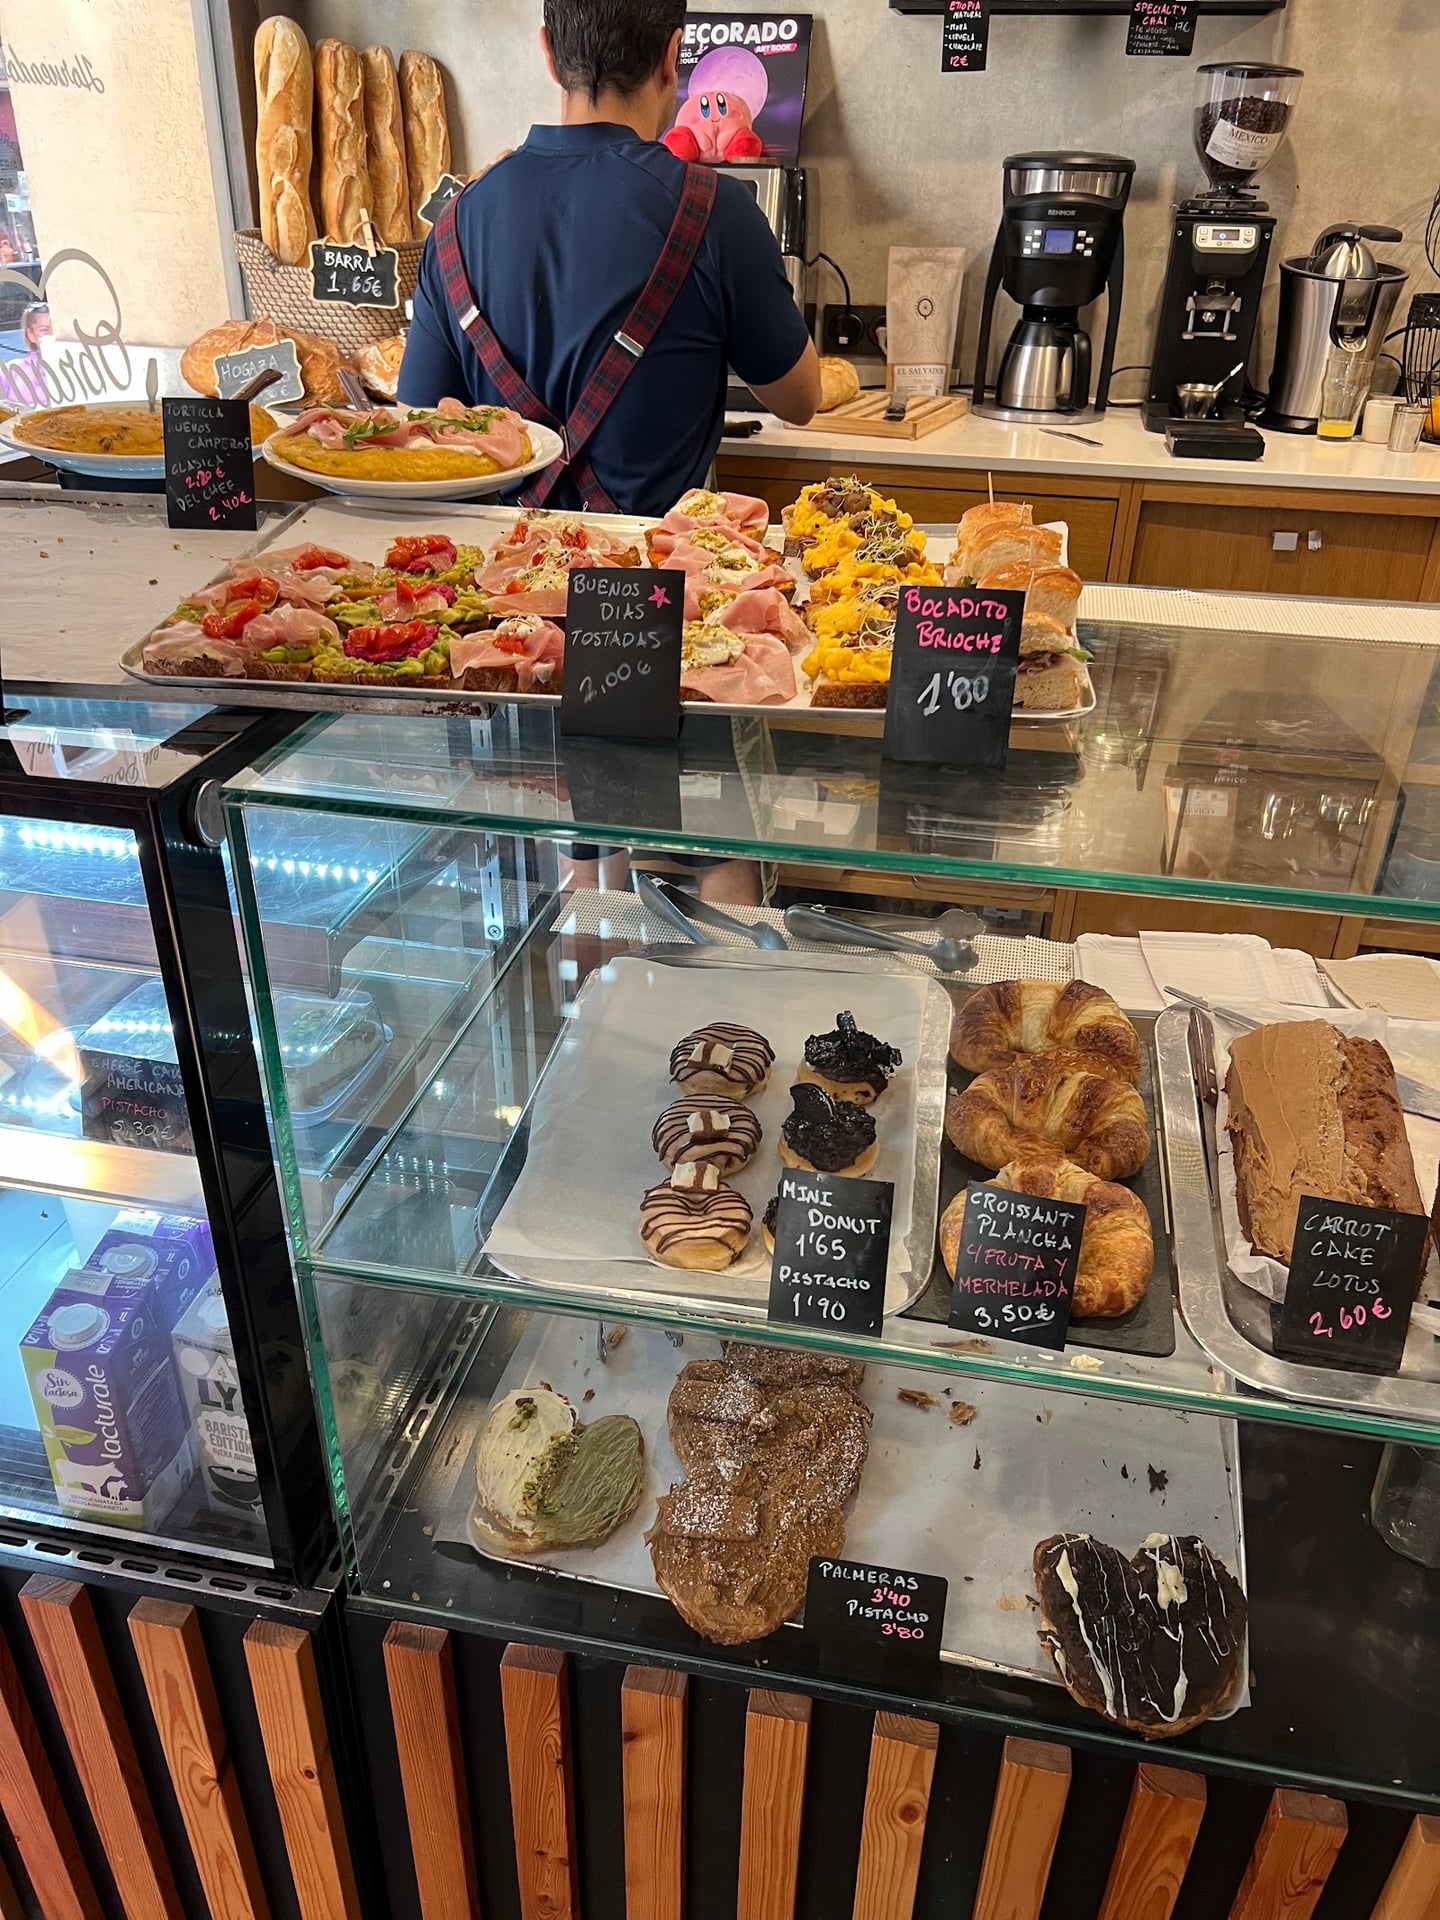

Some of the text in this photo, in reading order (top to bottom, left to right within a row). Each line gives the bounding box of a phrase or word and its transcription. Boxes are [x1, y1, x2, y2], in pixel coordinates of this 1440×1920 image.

[1134, 2, 1187, 16] SPECIALTY
[1142, 16, 1167, 26] CHAI
[682, 18, 798, 45] ECORADO
[1230, 128, 1269, 145] MEXICO
[324, 251, 375, 273] BARRA
[573, 573, 640, 597] BUENOS
[600, 603, 645, 621] DIAS
[904, 588, 1008, 620] BOCADITO
[571, 627, 661, 649] TOSTADAS
[916, 620, 1003, 654] BRIOCHE
[102, 1097, 168, 1119] PISTACHO
[782, 1179, 833, 1207] MINI
[808, 1208, 881, 1234] DONUT
[970, 1191, 1075, 1228] CROISSANT
[977, 1214, 1072, 1250] PLANCHA
[1304, 1214, 1391, 1241] CARROT
[1311, 1240, 1376, 1265] CAKE
[779, 1265, 871, 1290] PISTACHO
[1054, 1257, 1068, 1277] Y
[959, 1276, 1068, 1298] MERMELADA
[1312, 1271, 1380, 1294] LOTUS
[46, 1373, 71, 1388] Sin
[85, 1364, 122, 1459] lacturale
[819, 1561, 919, 1590] PALMERAS
[846, 1599, 930, 1624] PISTACHO
